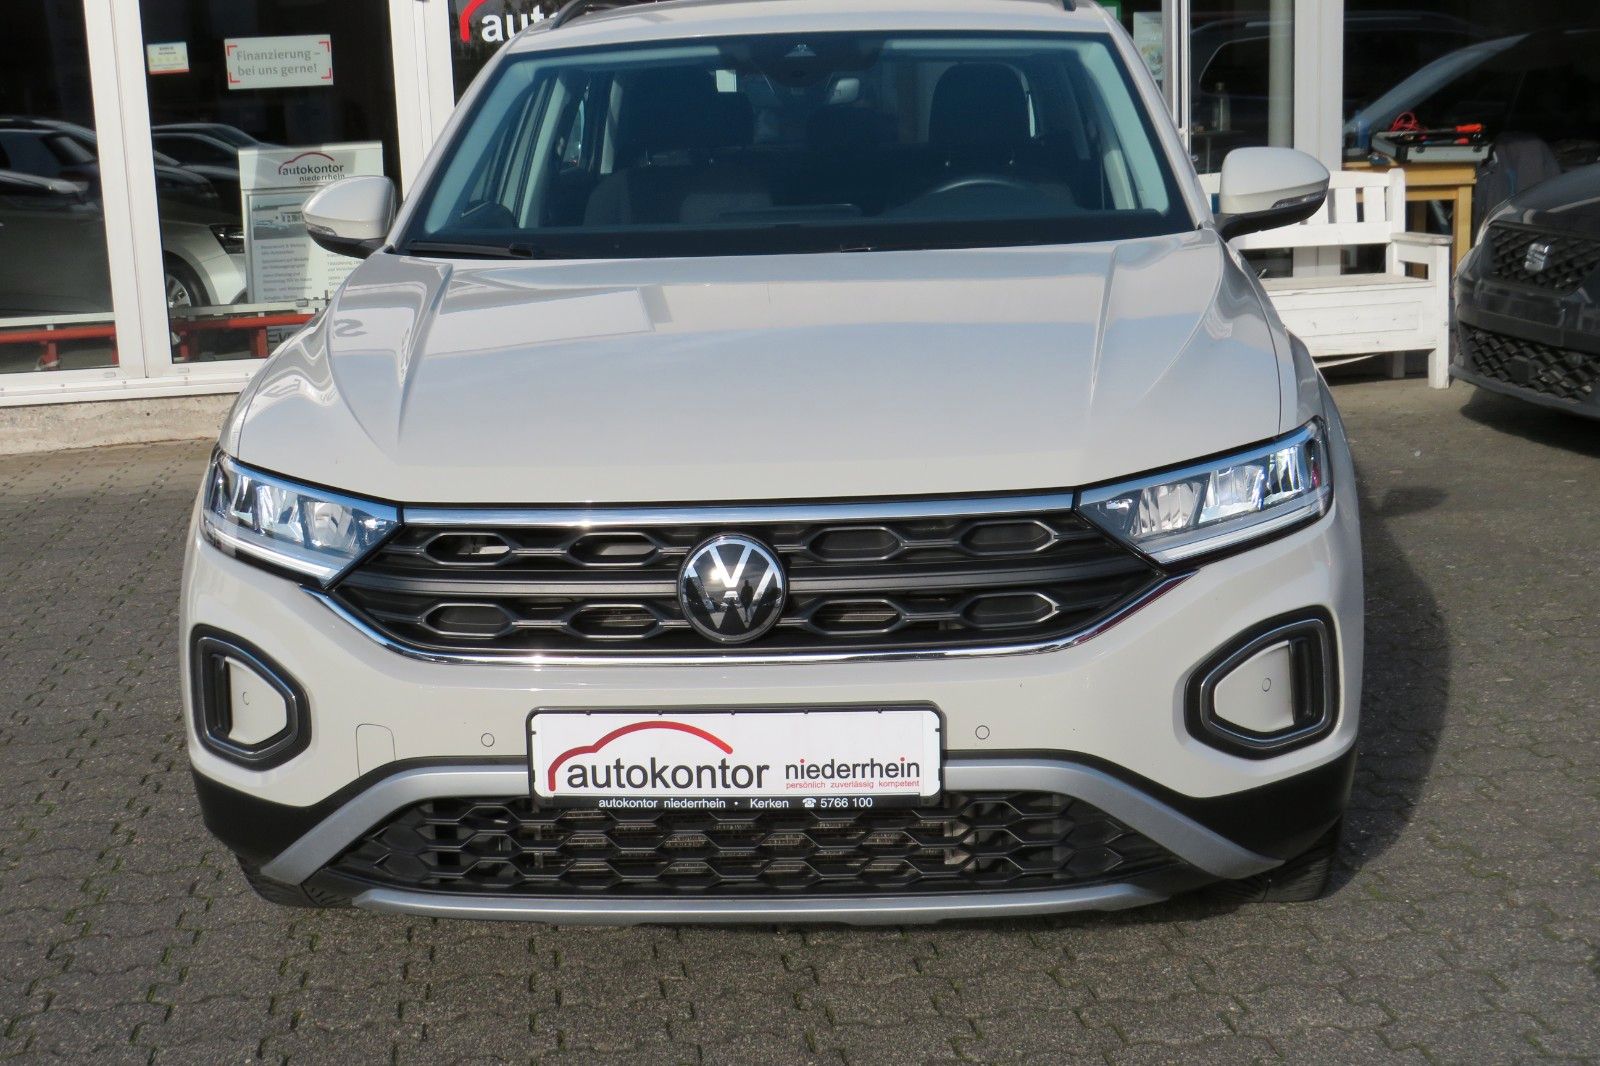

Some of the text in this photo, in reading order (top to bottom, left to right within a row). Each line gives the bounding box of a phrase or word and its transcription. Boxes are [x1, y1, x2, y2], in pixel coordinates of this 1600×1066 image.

[481, 5, 559, 42] aut
[236, 50, 311, 61] Finanzierung
[237, 63, 317, 77] bei uns gerne!
[282, 164, 344, 176] autokontor
[299, 173, 345, 182] niederrhein
[566, 757, 770, 789] autokontor
[785, 757, 920, 780] niederrhein
[786, 780, 920, 790] persönlich zuverlässig kompetent
[598, 797, 873, 809] autokontor niederrhein Kerken 5766 100
